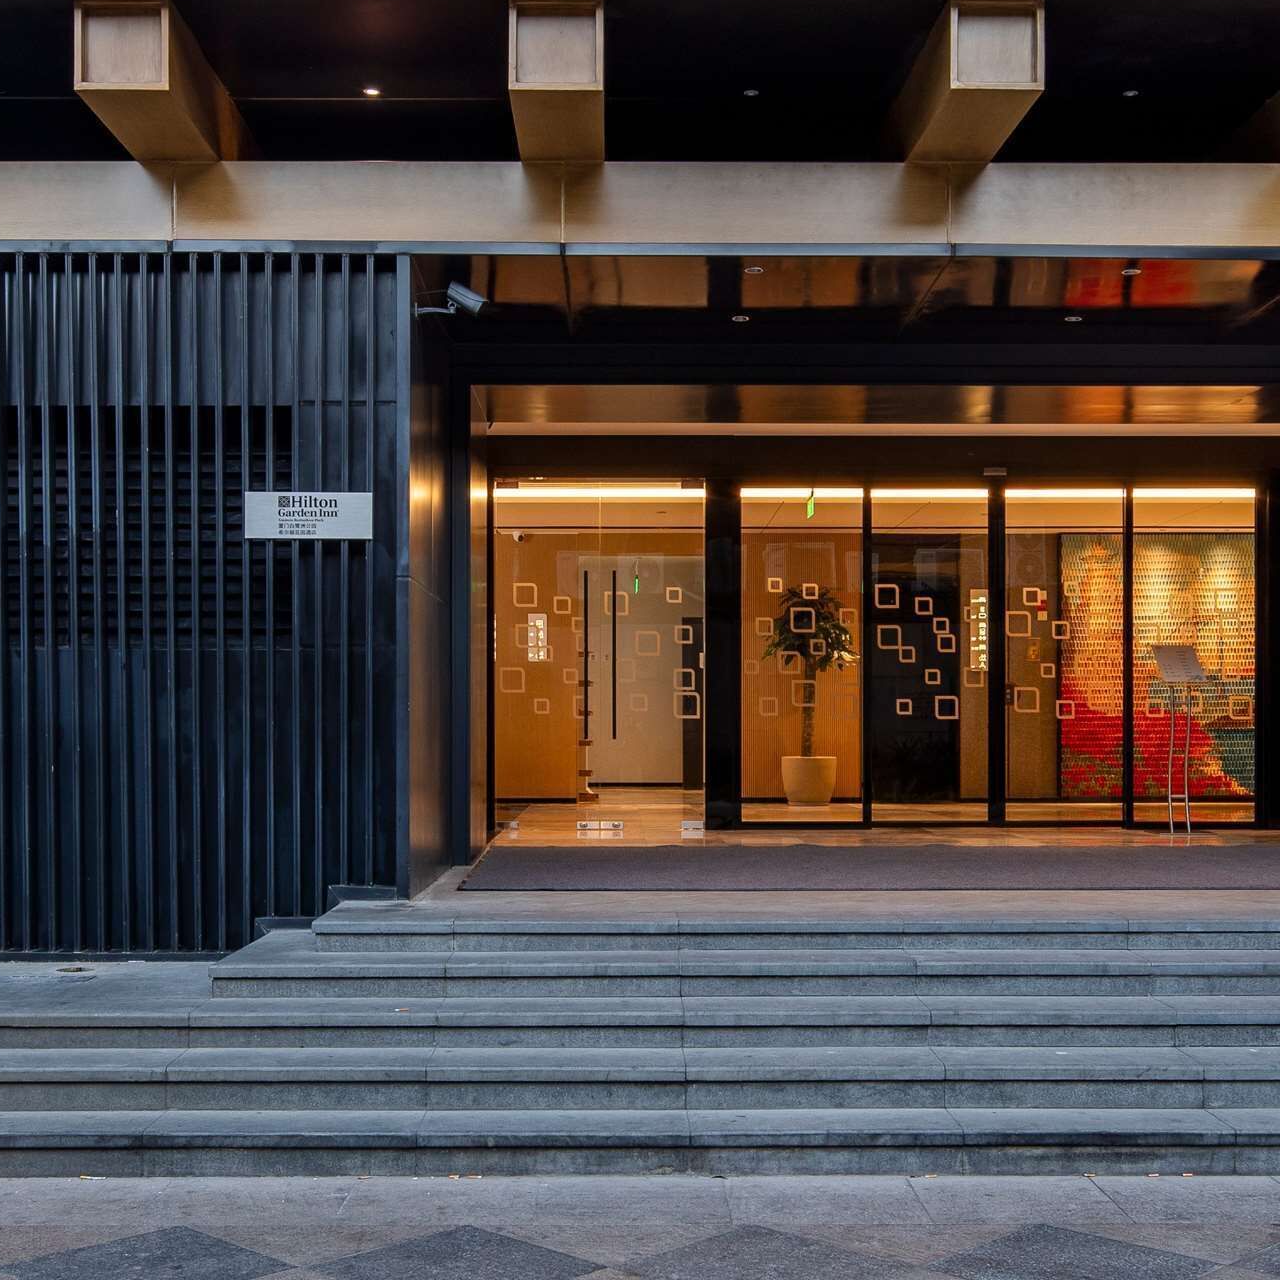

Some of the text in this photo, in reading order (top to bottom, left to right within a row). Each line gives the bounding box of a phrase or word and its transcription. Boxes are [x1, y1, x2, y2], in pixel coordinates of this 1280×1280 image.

[291, 495, 338, 508] Hilton
[278, 508, 338, 518] Garden Inn
